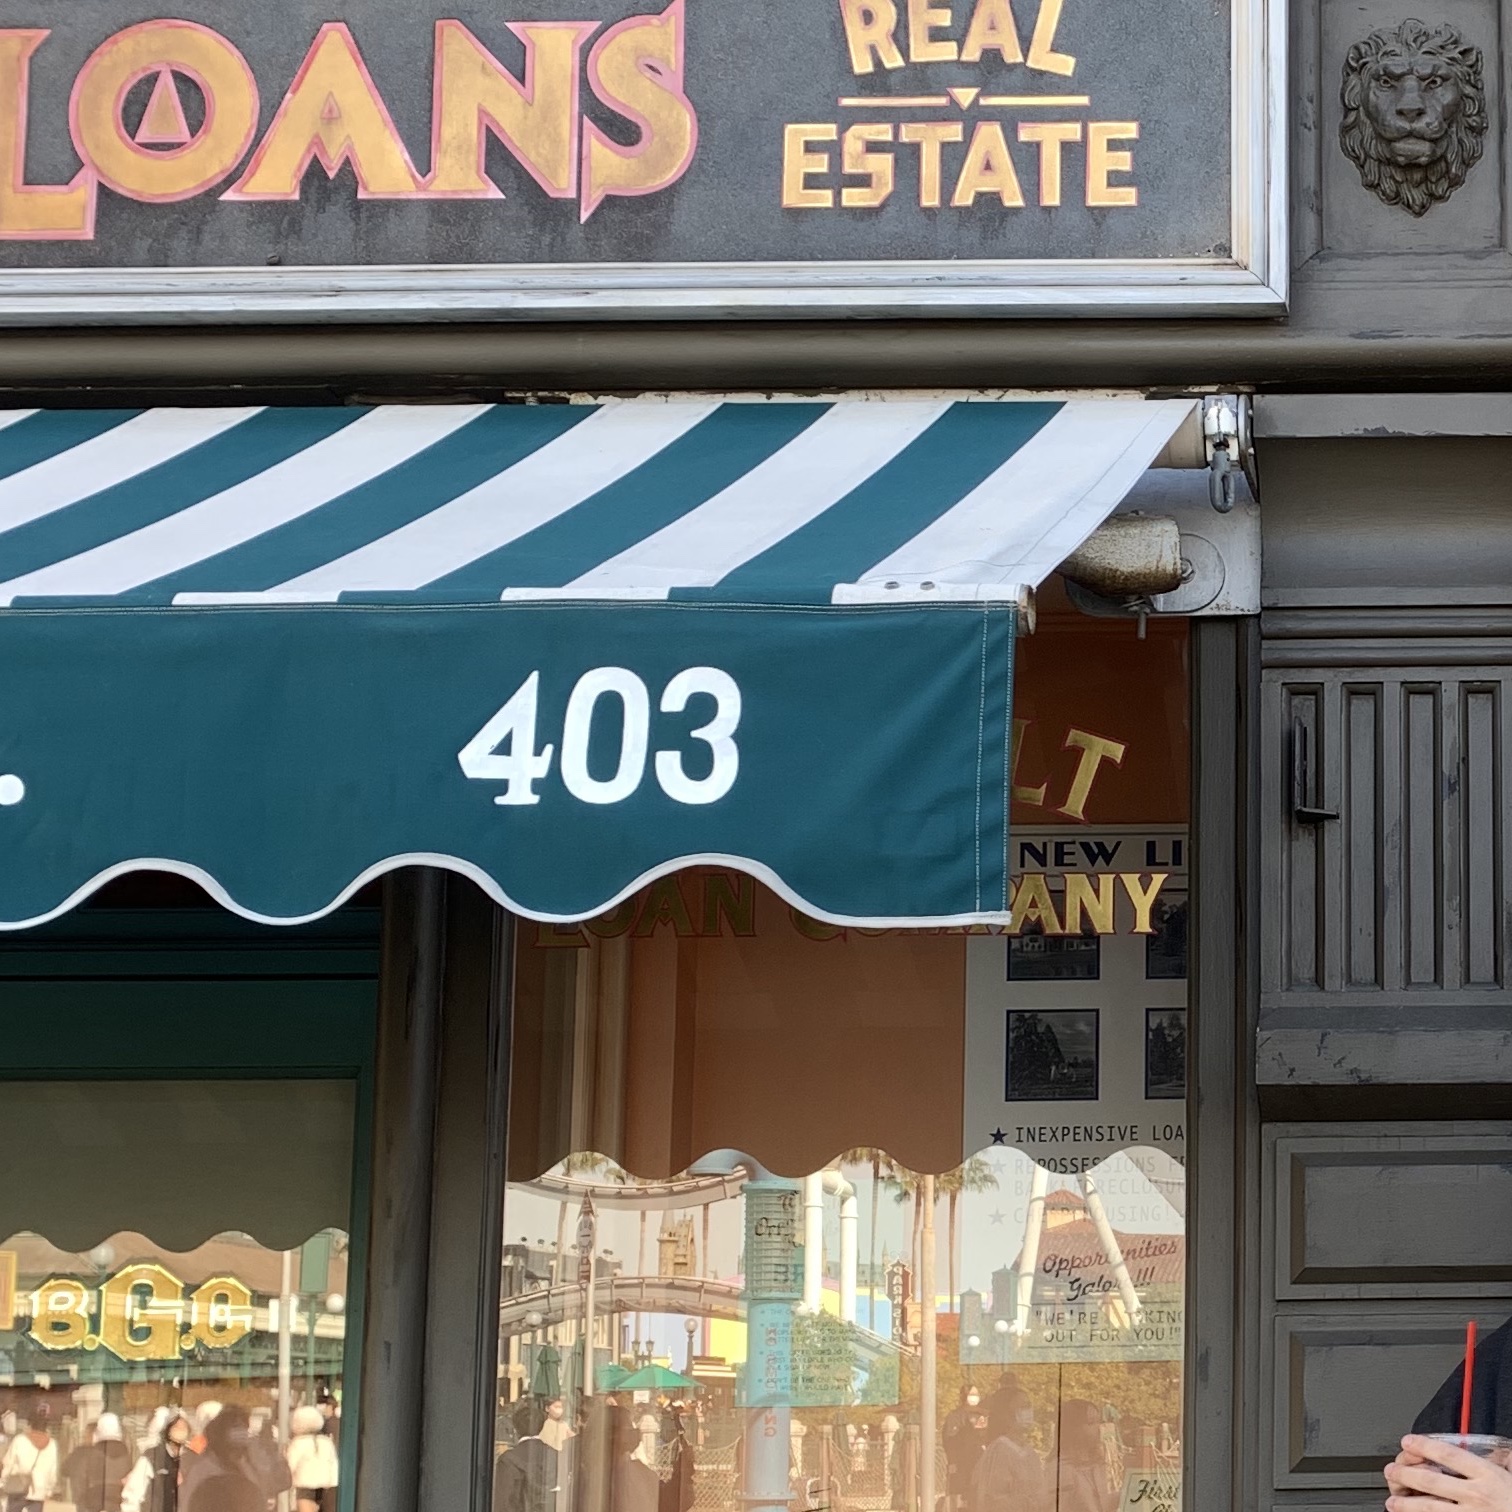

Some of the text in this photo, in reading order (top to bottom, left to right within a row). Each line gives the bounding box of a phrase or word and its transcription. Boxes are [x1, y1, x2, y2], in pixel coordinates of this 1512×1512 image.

[840, 0, 1077, 76] REAL
[0, 0, 697, 240] LOANS
[781, 120, 1140, 208] ESTATE
[458, 666, 742, 805] 403
[1019, 840, 1122, 868] NEW
[1015, 1125, 1139, 1143] INEXPENSIVE
[1043, 1237, 1178, 1276] Oppornities
[1090, 1328, 1120, 1341] FOR
